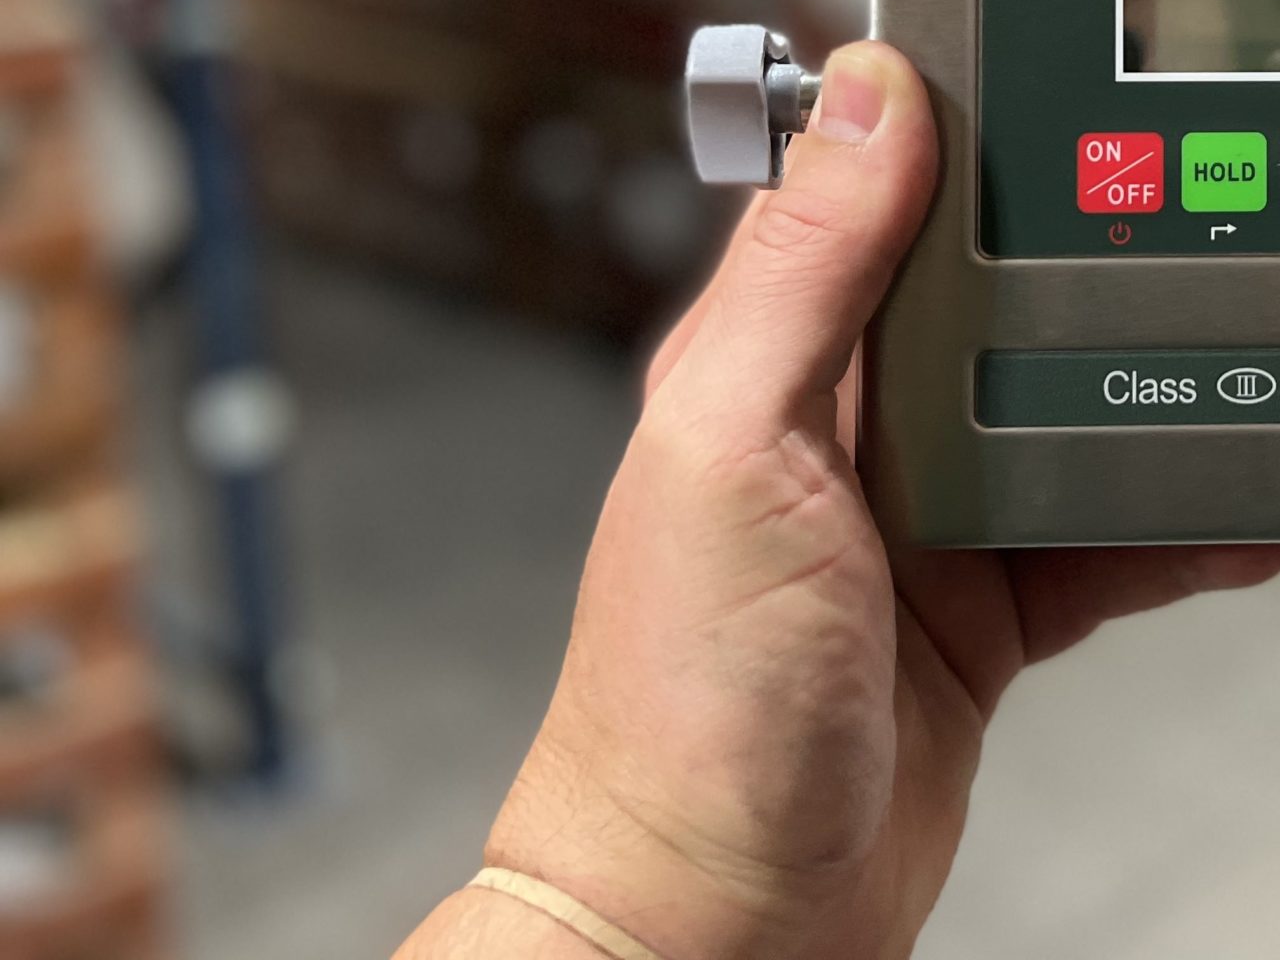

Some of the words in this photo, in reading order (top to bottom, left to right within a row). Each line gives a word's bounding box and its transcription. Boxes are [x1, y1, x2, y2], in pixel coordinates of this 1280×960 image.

[1086, 141, 1122, 163] ON
[1193, 162, 1256, 182] HOLD
[1107, 184, 1155, 206] OFF
[1102, 370, 1197, 405] Class
